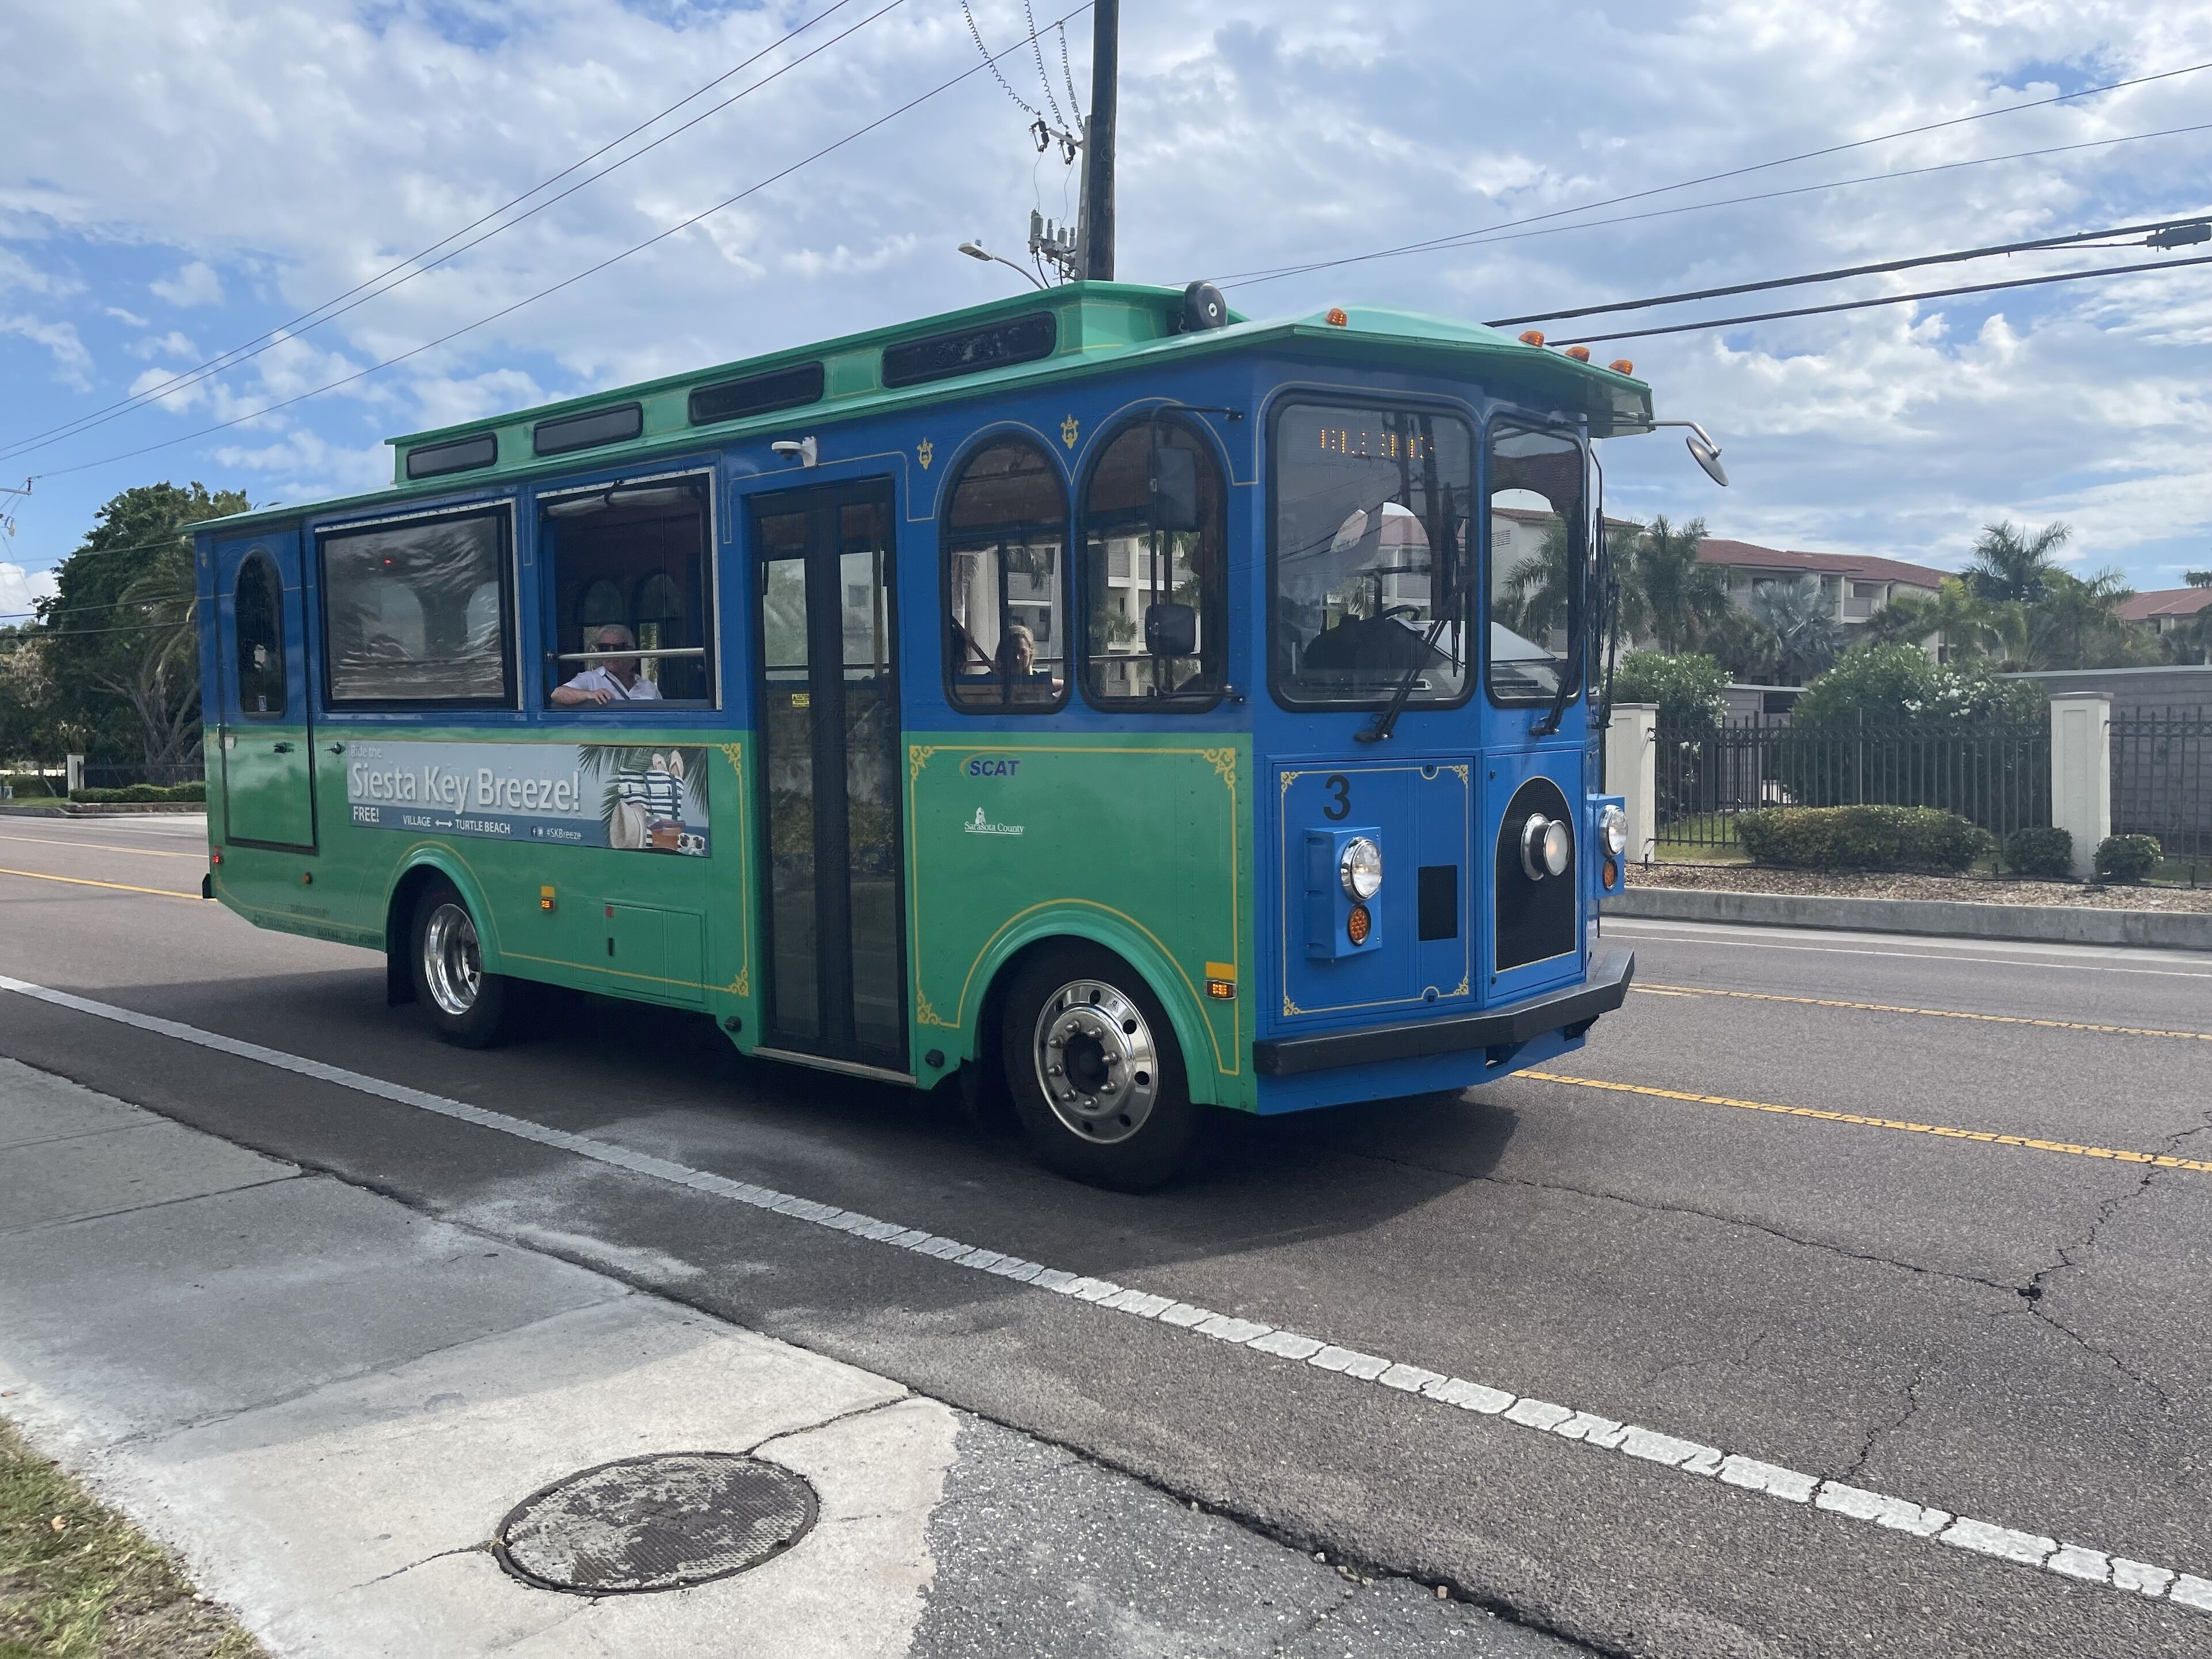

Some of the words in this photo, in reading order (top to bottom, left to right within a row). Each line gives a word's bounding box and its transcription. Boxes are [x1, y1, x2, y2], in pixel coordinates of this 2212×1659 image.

[350, 745, 368, 757] Ride
[369, 746, 382, 758] the
[969, 760, 1020, 777] SCAT
[352, 762, 416, 801] Siesta
[424, 765, 470, 815] Key
[478, 767, 579, 811] Breeze!
[1323, 774, 1351, 821] 3
[353, 806, 380, 823] FREE!
[403, 815, 432, 827] VILLAGE
[455, 819, 483, 832] TURTLE
[484, 821, 512, 834] BEACH
[964, 821, 996, 831] Sarasota
[997, 823, 1024, 834] County
[546, 828, 582, 840] #SKBreeze
